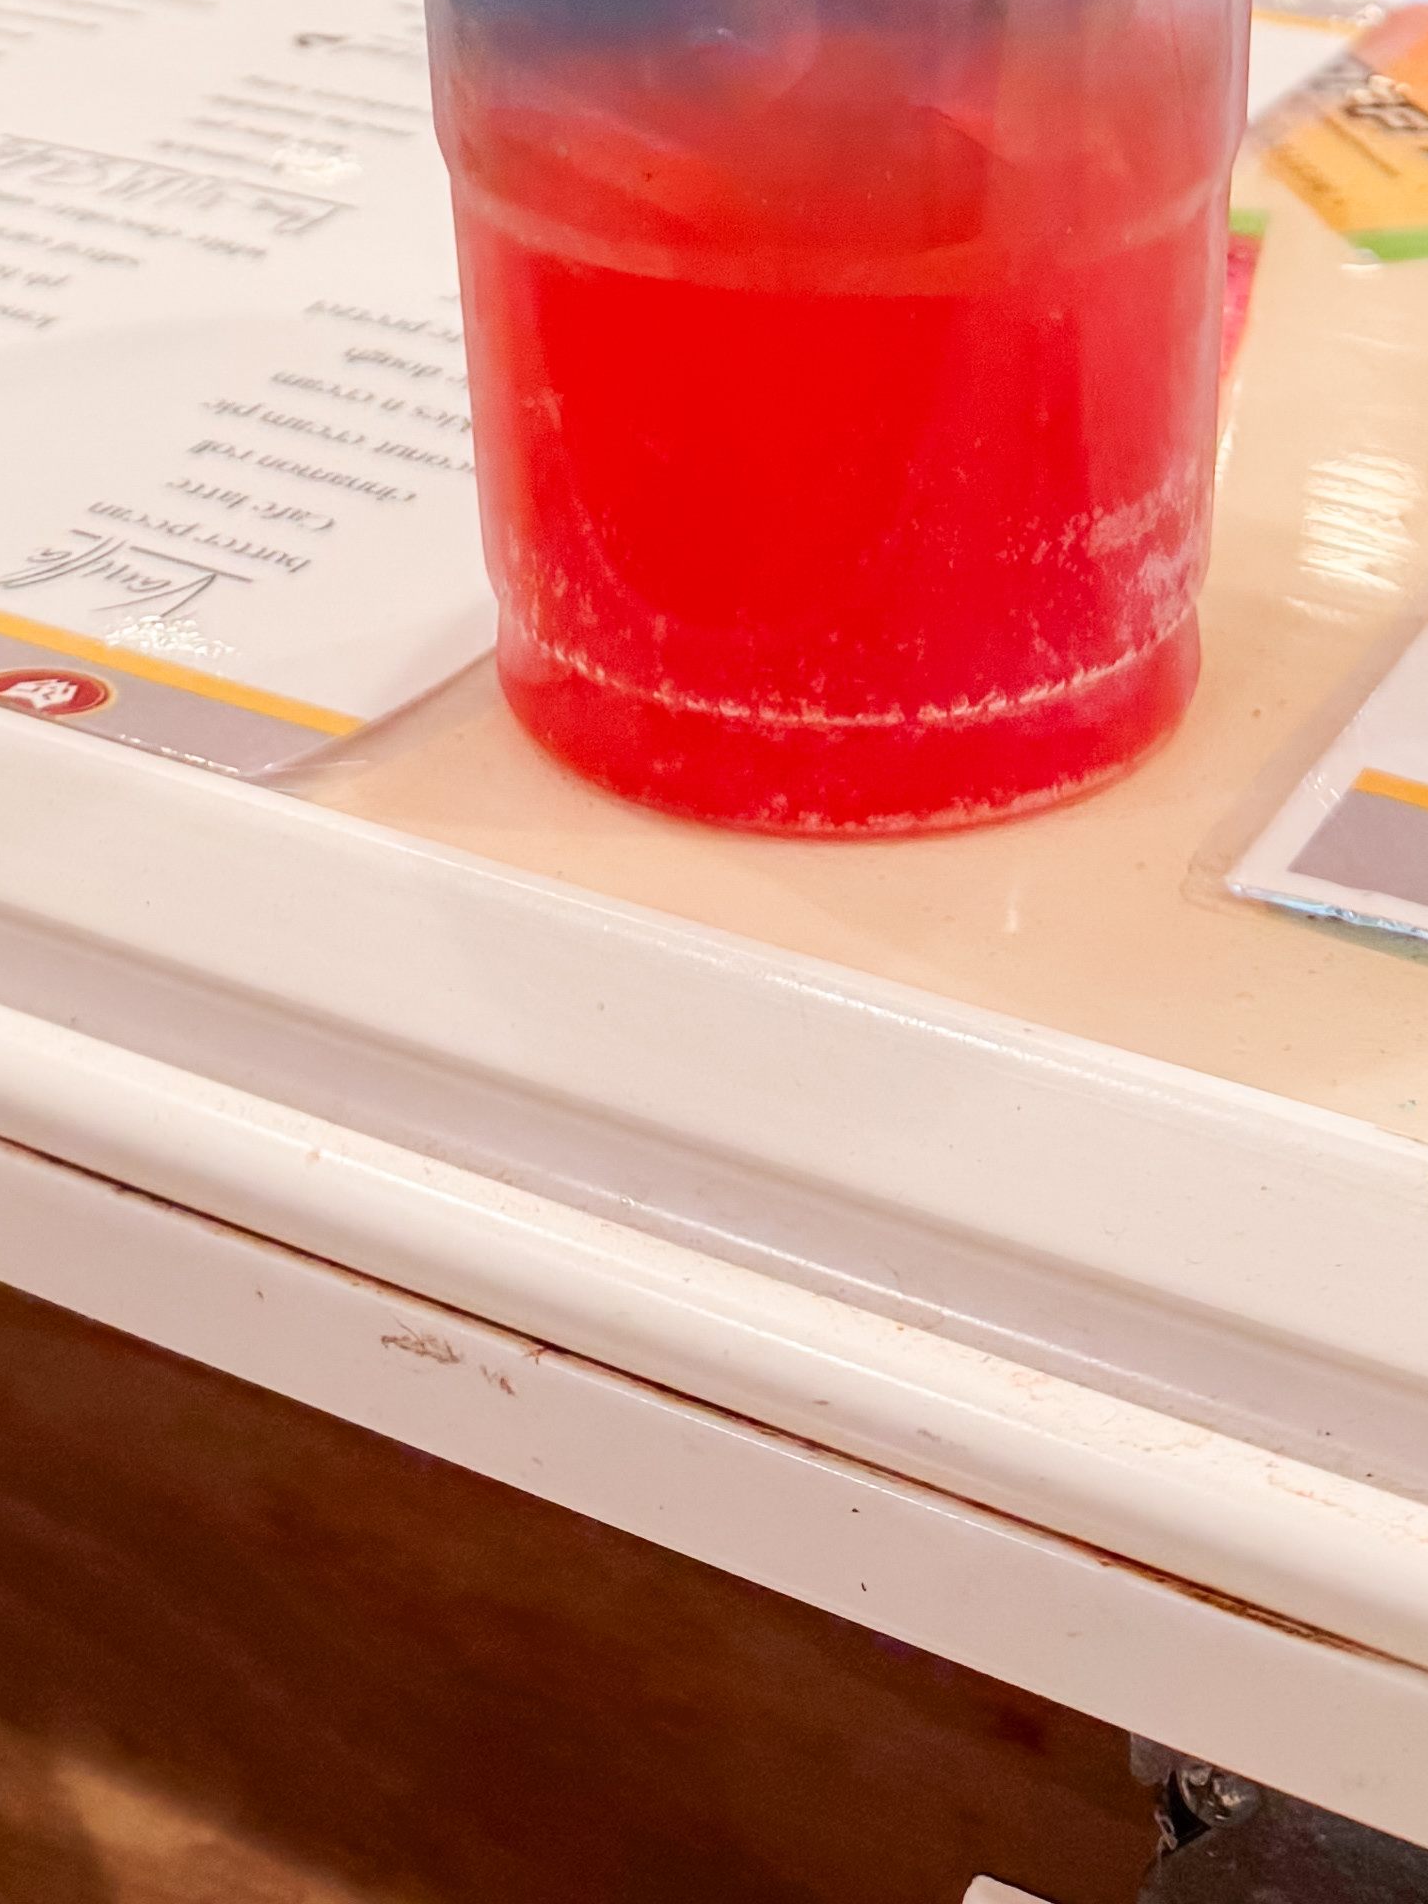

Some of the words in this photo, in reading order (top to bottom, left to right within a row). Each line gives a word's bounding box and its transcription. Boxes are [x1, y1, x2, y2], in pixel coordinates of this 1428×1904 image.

[269, 371, 376, 405] cream
[200, 398, 262, 420] pie
[256, 410, 367, 447] cream
[185, 439, 256, 466] roll
[164, 478, 251, 510] latte
[256, 454, 417, 505] cinnamon
[87, 501, 201, 542] pecan
[250, 501, 336, 533] Cafe
[194, 533, 311, 574] butter
